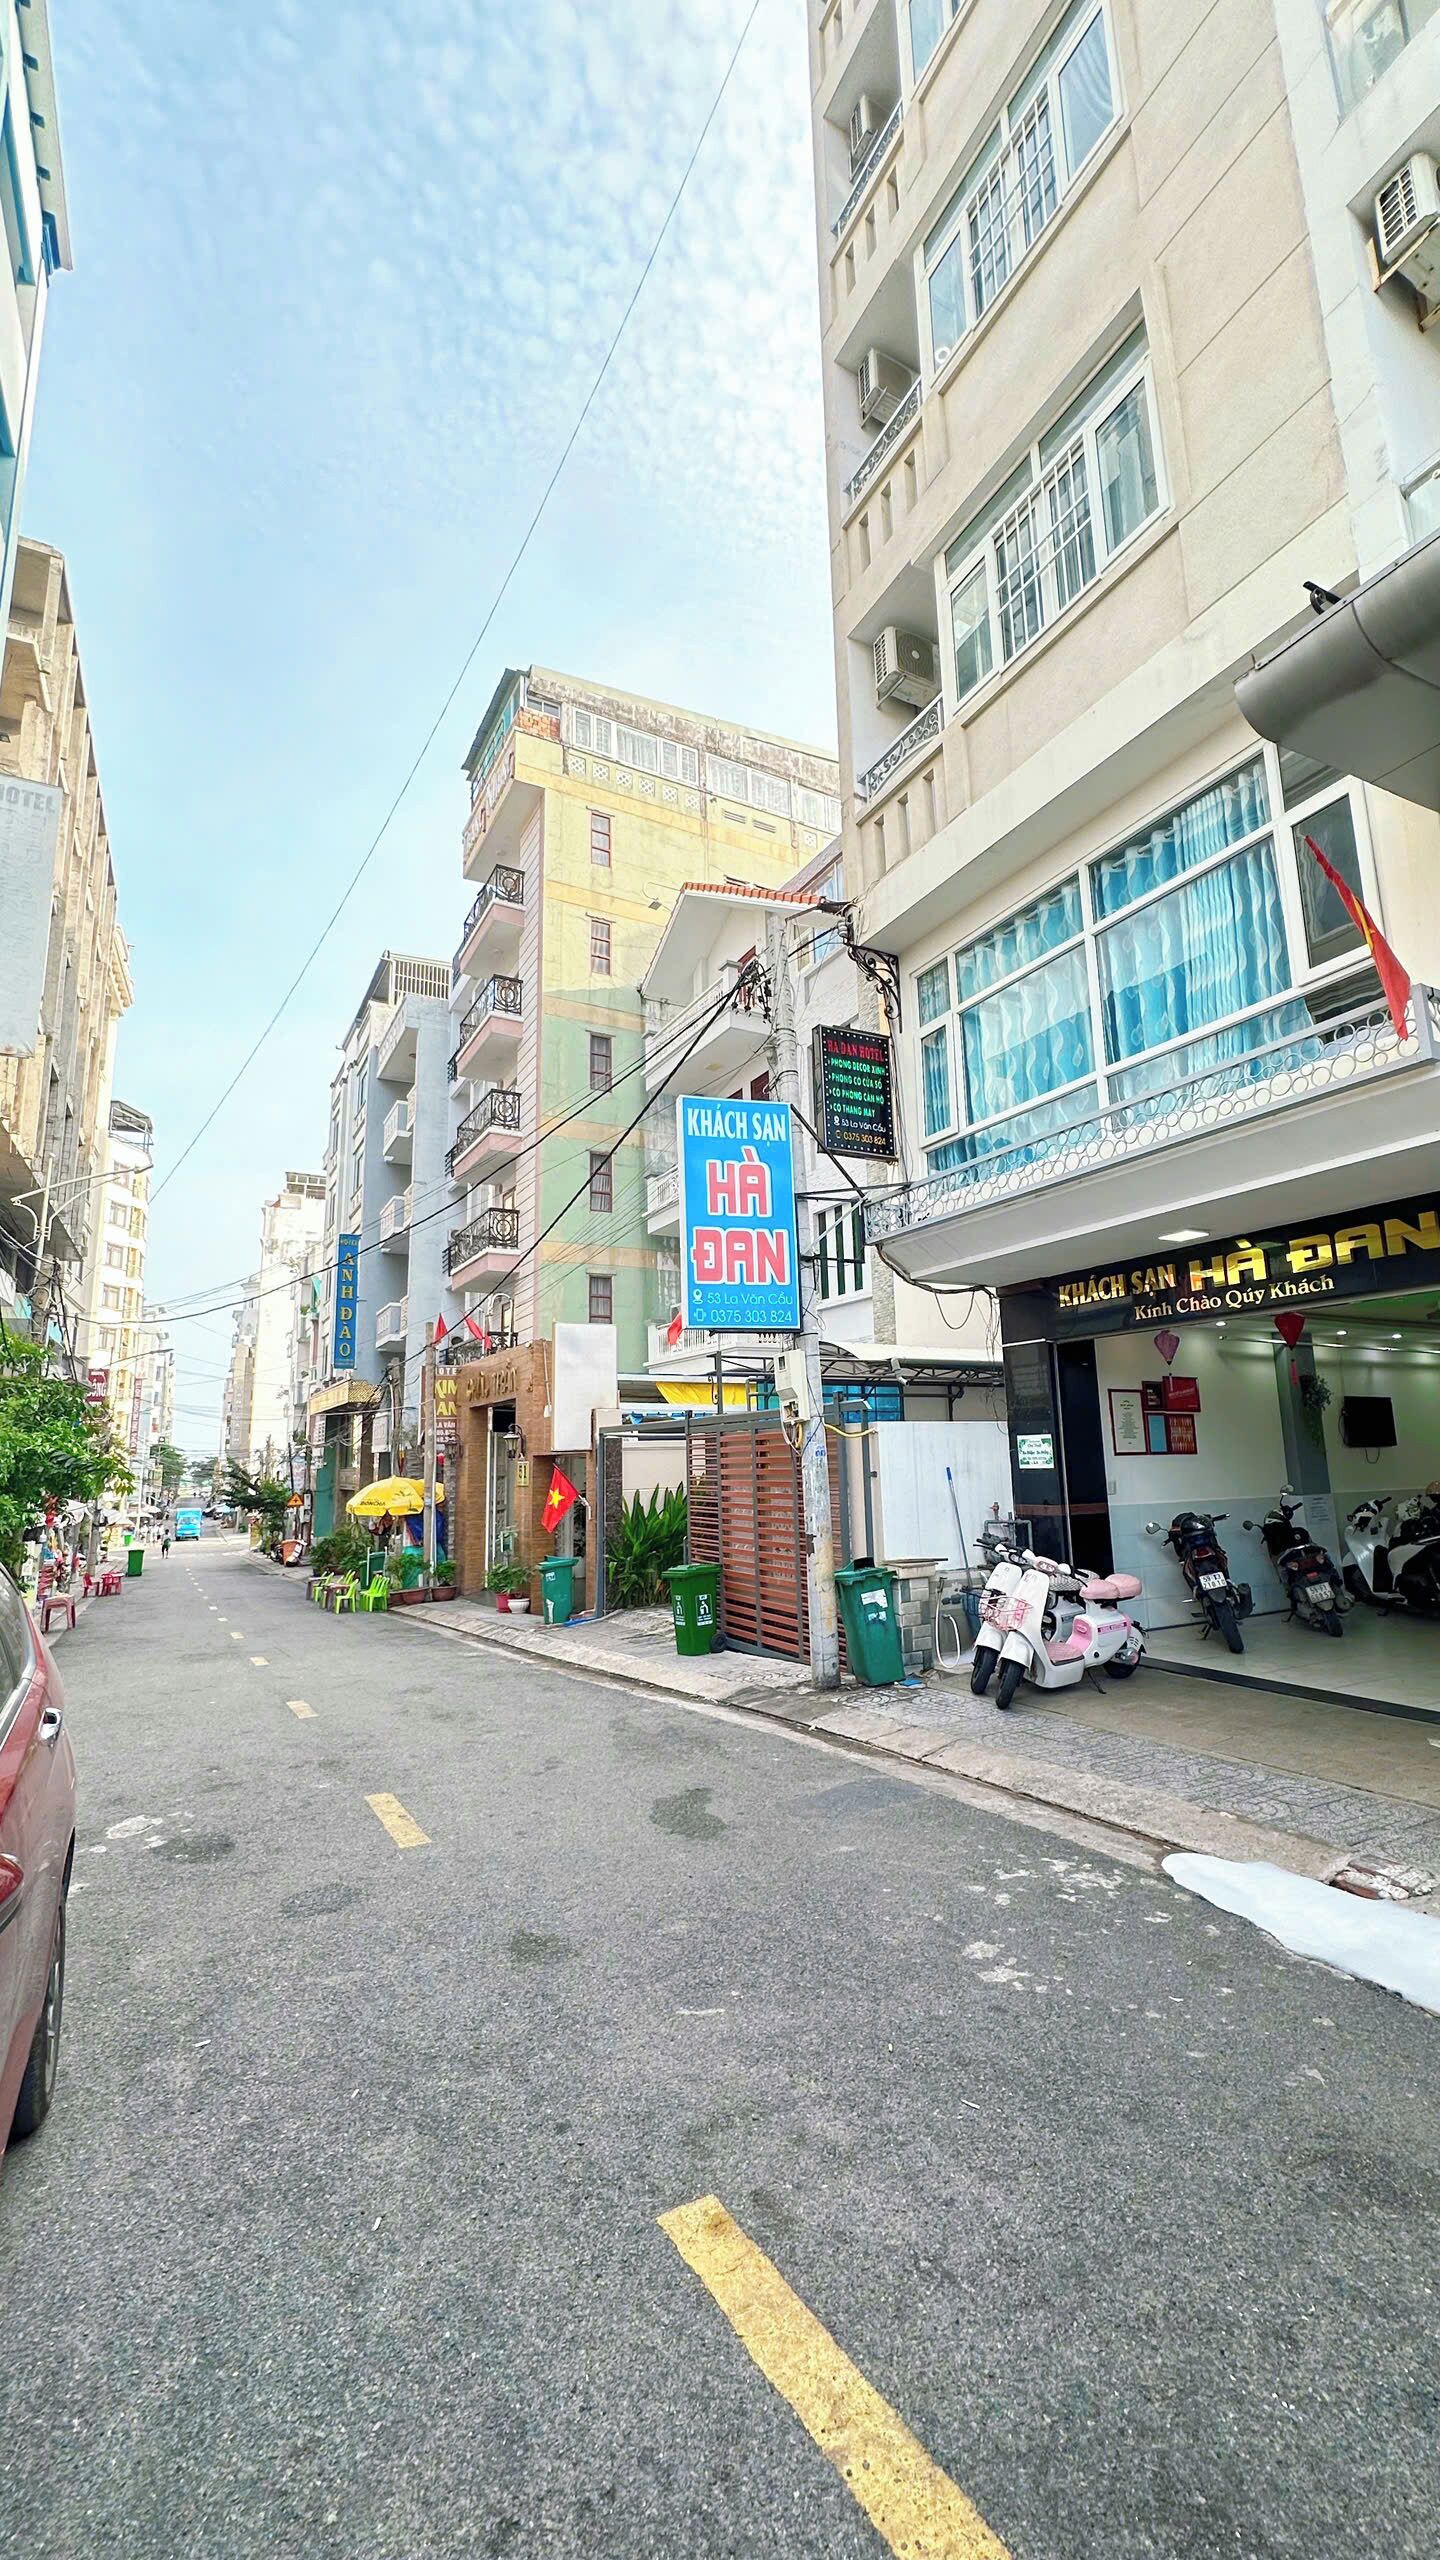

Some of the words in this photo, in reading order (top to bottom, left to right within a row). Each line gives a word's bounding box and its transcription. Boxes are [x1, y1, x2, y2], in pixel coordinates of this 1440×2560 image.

[860, 1047, 884, 1062] HOTEL
[852, 1062, 871, 1073] DECOR
[842, 1105, 862, 1116] THANG
[687, 1104, 749, 1140] KHÁCH
[752, 1112, 787, 1147] SẠN
[841, 1119, 849, 1127] 53
[843, 1131, 860, 1142] 0375
[861, 1134, 874, 1144] 303
[874, 1136, 887, 1146] 824
[706, 1145, 772, 1217] HÀ
[691, 1226, 791, 1286] ĐAN
[1058, 1274, 1126, 1308] KHÁCH
[1131, 1264, 1176, 1297] SẠN
[1188, 1239, 1267, 1292] HÀ
[1286, 1210, 1440, 1274] ĐAN
[341, 1252, 355, 1299] ANH
[707, 1292, 721, 1304] 53
[724, 1293, 739, 1304] La
[1134, 1302, 1173, 1320] Kính
[1176, 1294, 1222, 1315] Chào
[1269, 1274, 1335, 1300] Khách
[711, 1309, 741, 1323] 0375
[744, 1310, 767, 1323] 303
[770, 1310, 793, 1323] 824
[436, 1401, 457, 1416] AN
